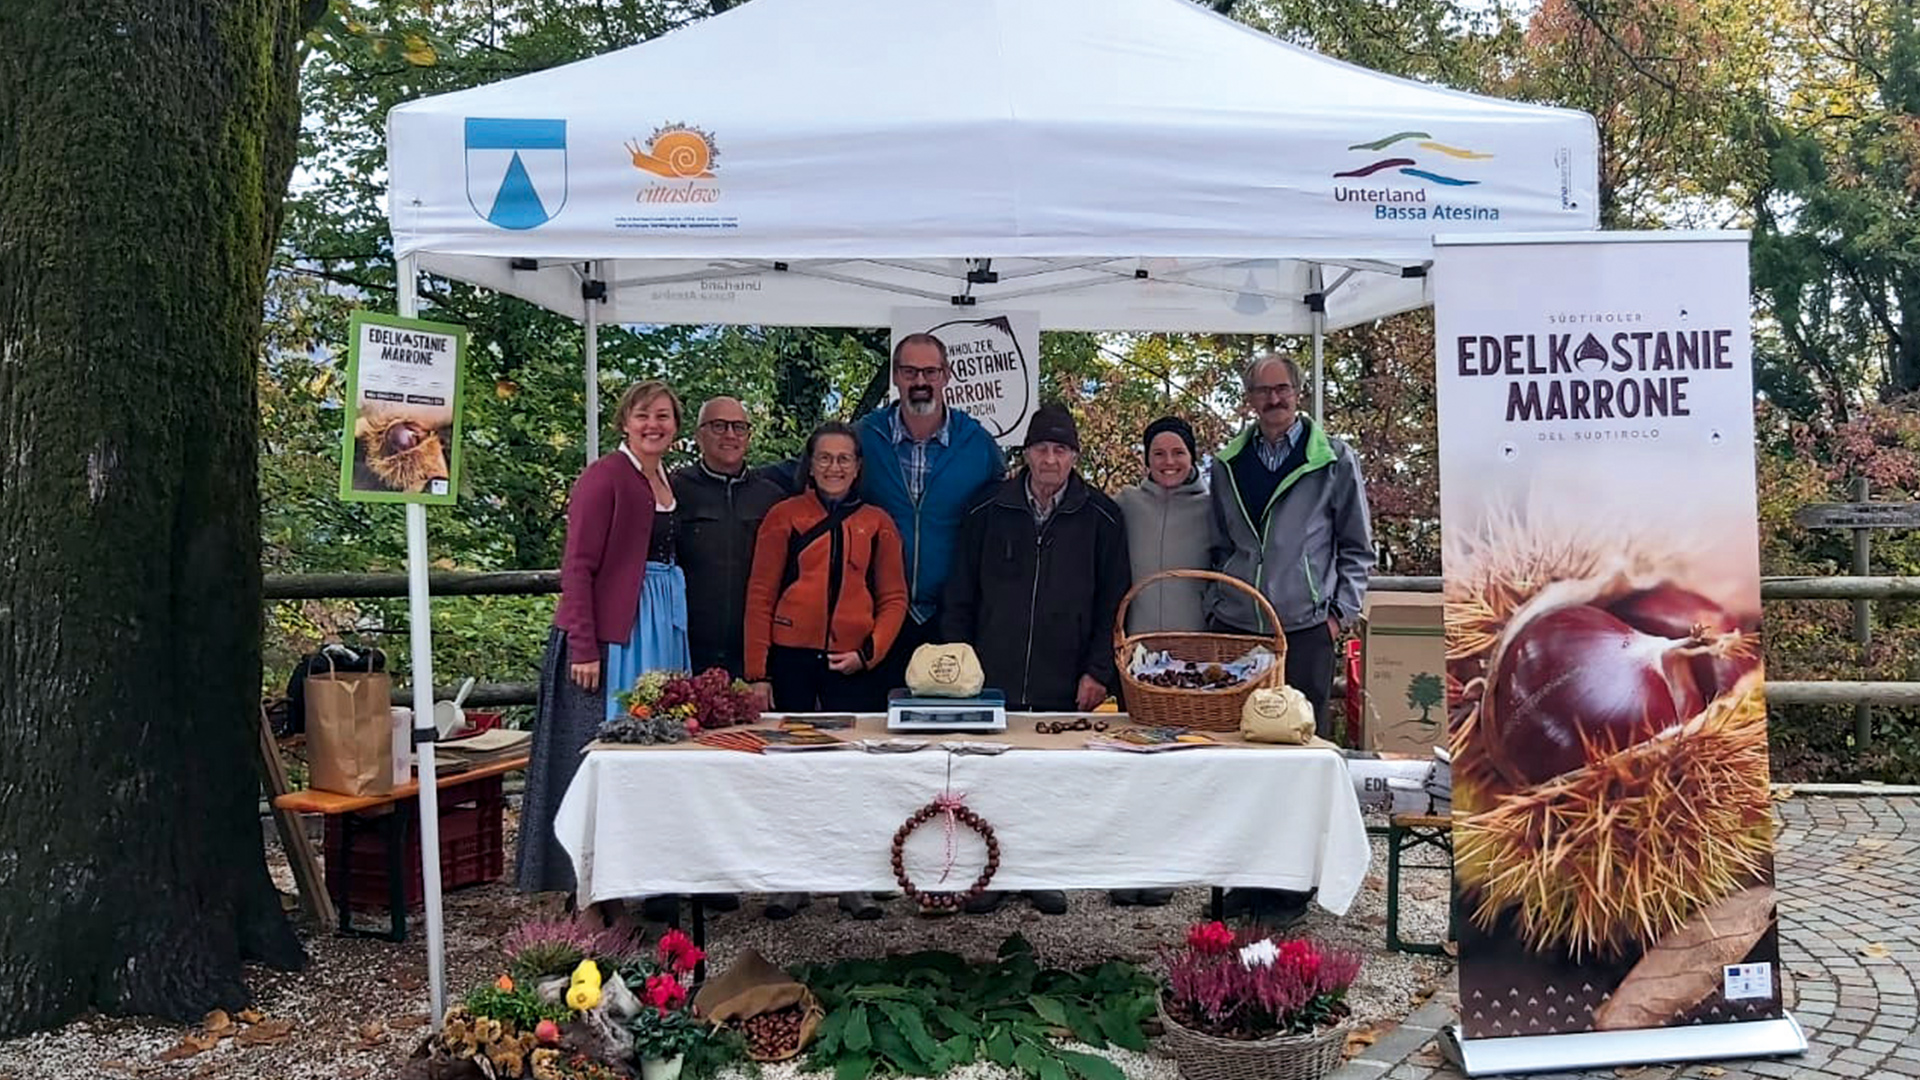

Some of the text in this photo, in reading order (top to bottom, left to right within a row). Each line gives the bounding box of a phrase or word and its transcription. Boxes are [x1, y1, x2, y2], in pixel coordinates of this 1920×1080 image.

[636, 181, 720, 203] cittaslow
[1335, 187, 1426, 202] Unterland
[1376, 205, 1499, 220] Bassa Atesina
[381, 346, 434, 366] MARRONE
[950, 351, 1017, 382] KASTANIE
[945, 380, 1003, 405] ARRONE
[1505, 377, 1690, 422] MARRONE
[1538, 432, 1565, 442] DEL
